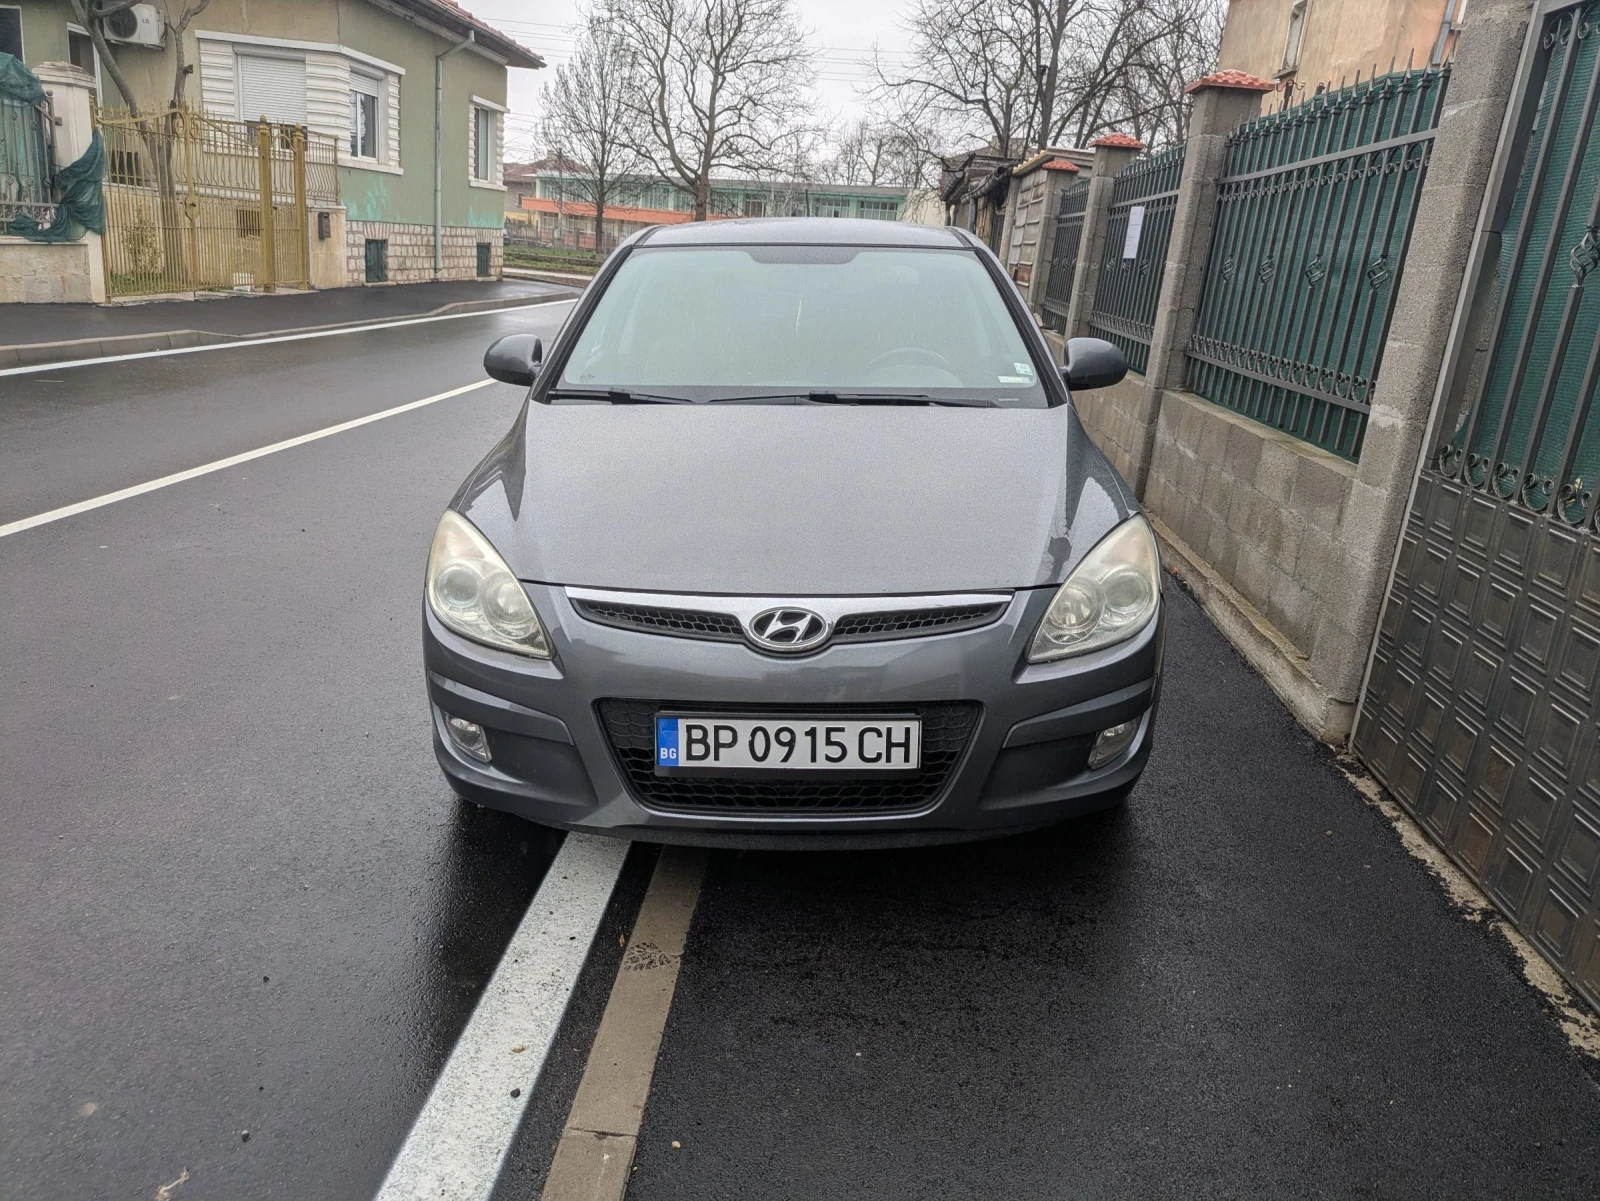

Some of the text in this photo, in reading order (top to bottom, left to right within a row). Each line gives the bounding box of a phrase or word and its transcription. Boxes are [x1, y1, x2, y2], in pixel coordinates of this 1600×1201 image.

[660, 747, 677, 759] BG
[685, 725, 910, 763] BP 0915 CH
